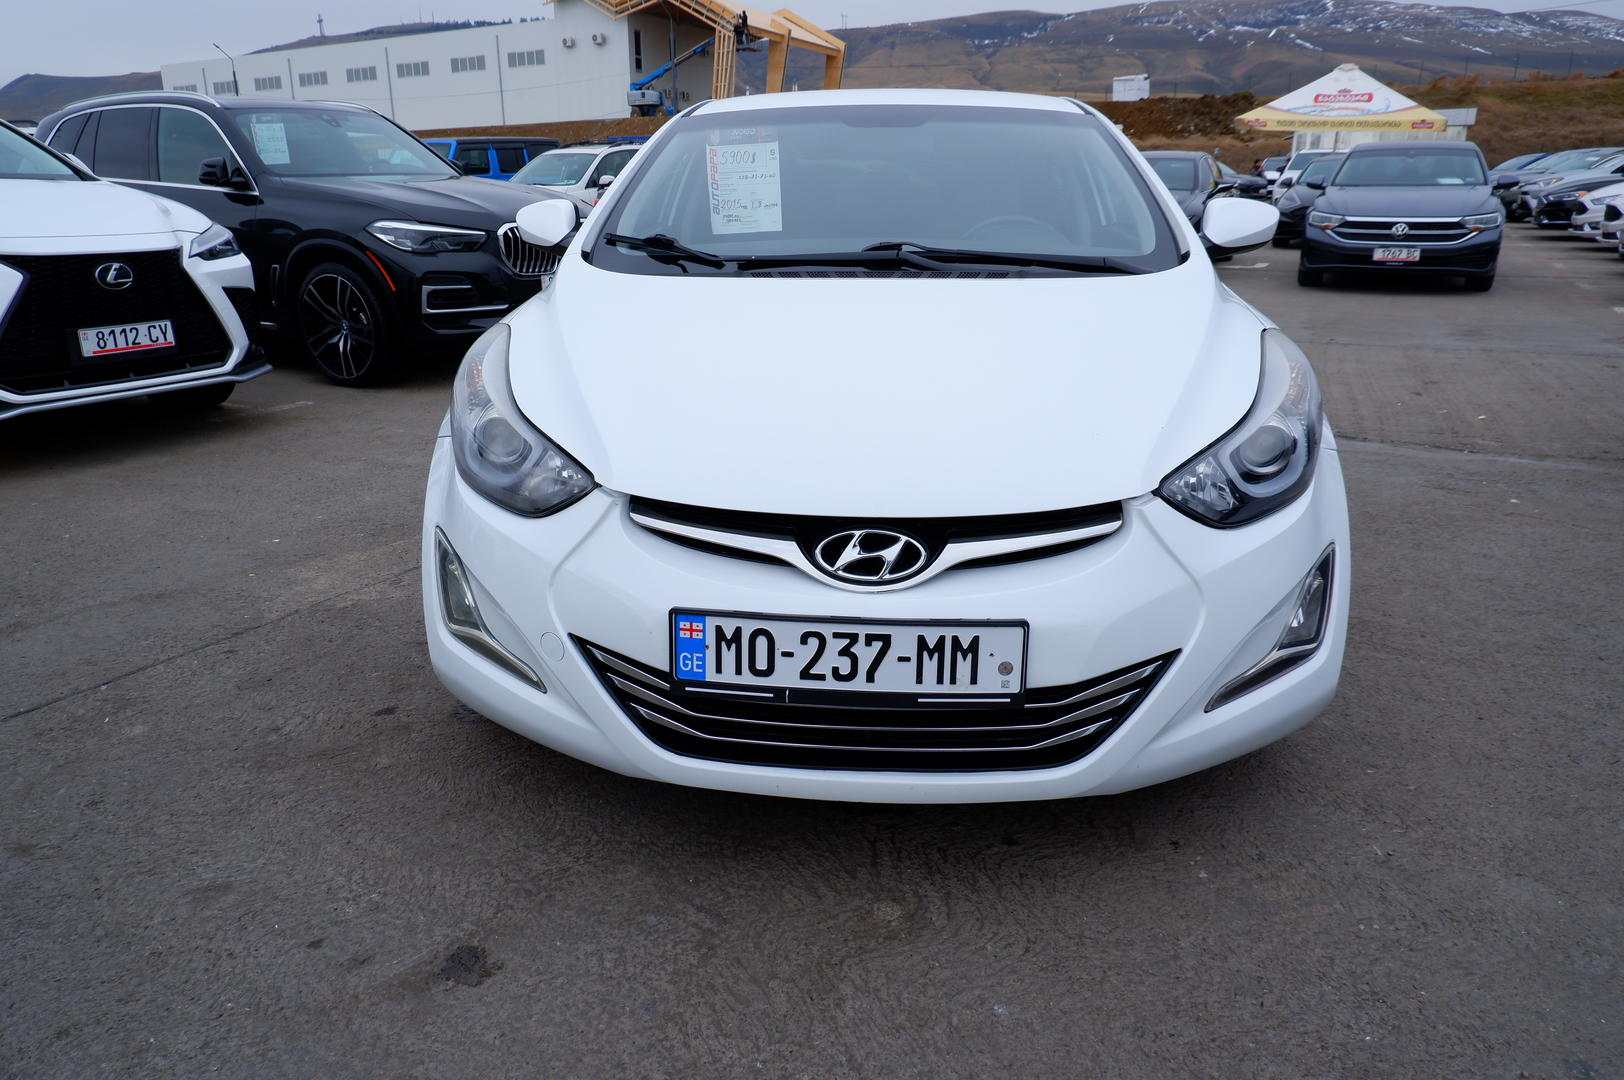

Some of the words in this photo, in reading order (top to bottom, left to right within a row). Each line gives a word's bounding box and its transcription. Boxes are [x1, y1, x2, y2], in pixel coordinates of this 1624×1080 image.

[96, 327, 141, 350] 8112
[147, 323, 168, 343] CY
[679, 652, 704, 673] GE
[715, 624, 980, 686] MO-237-MM
